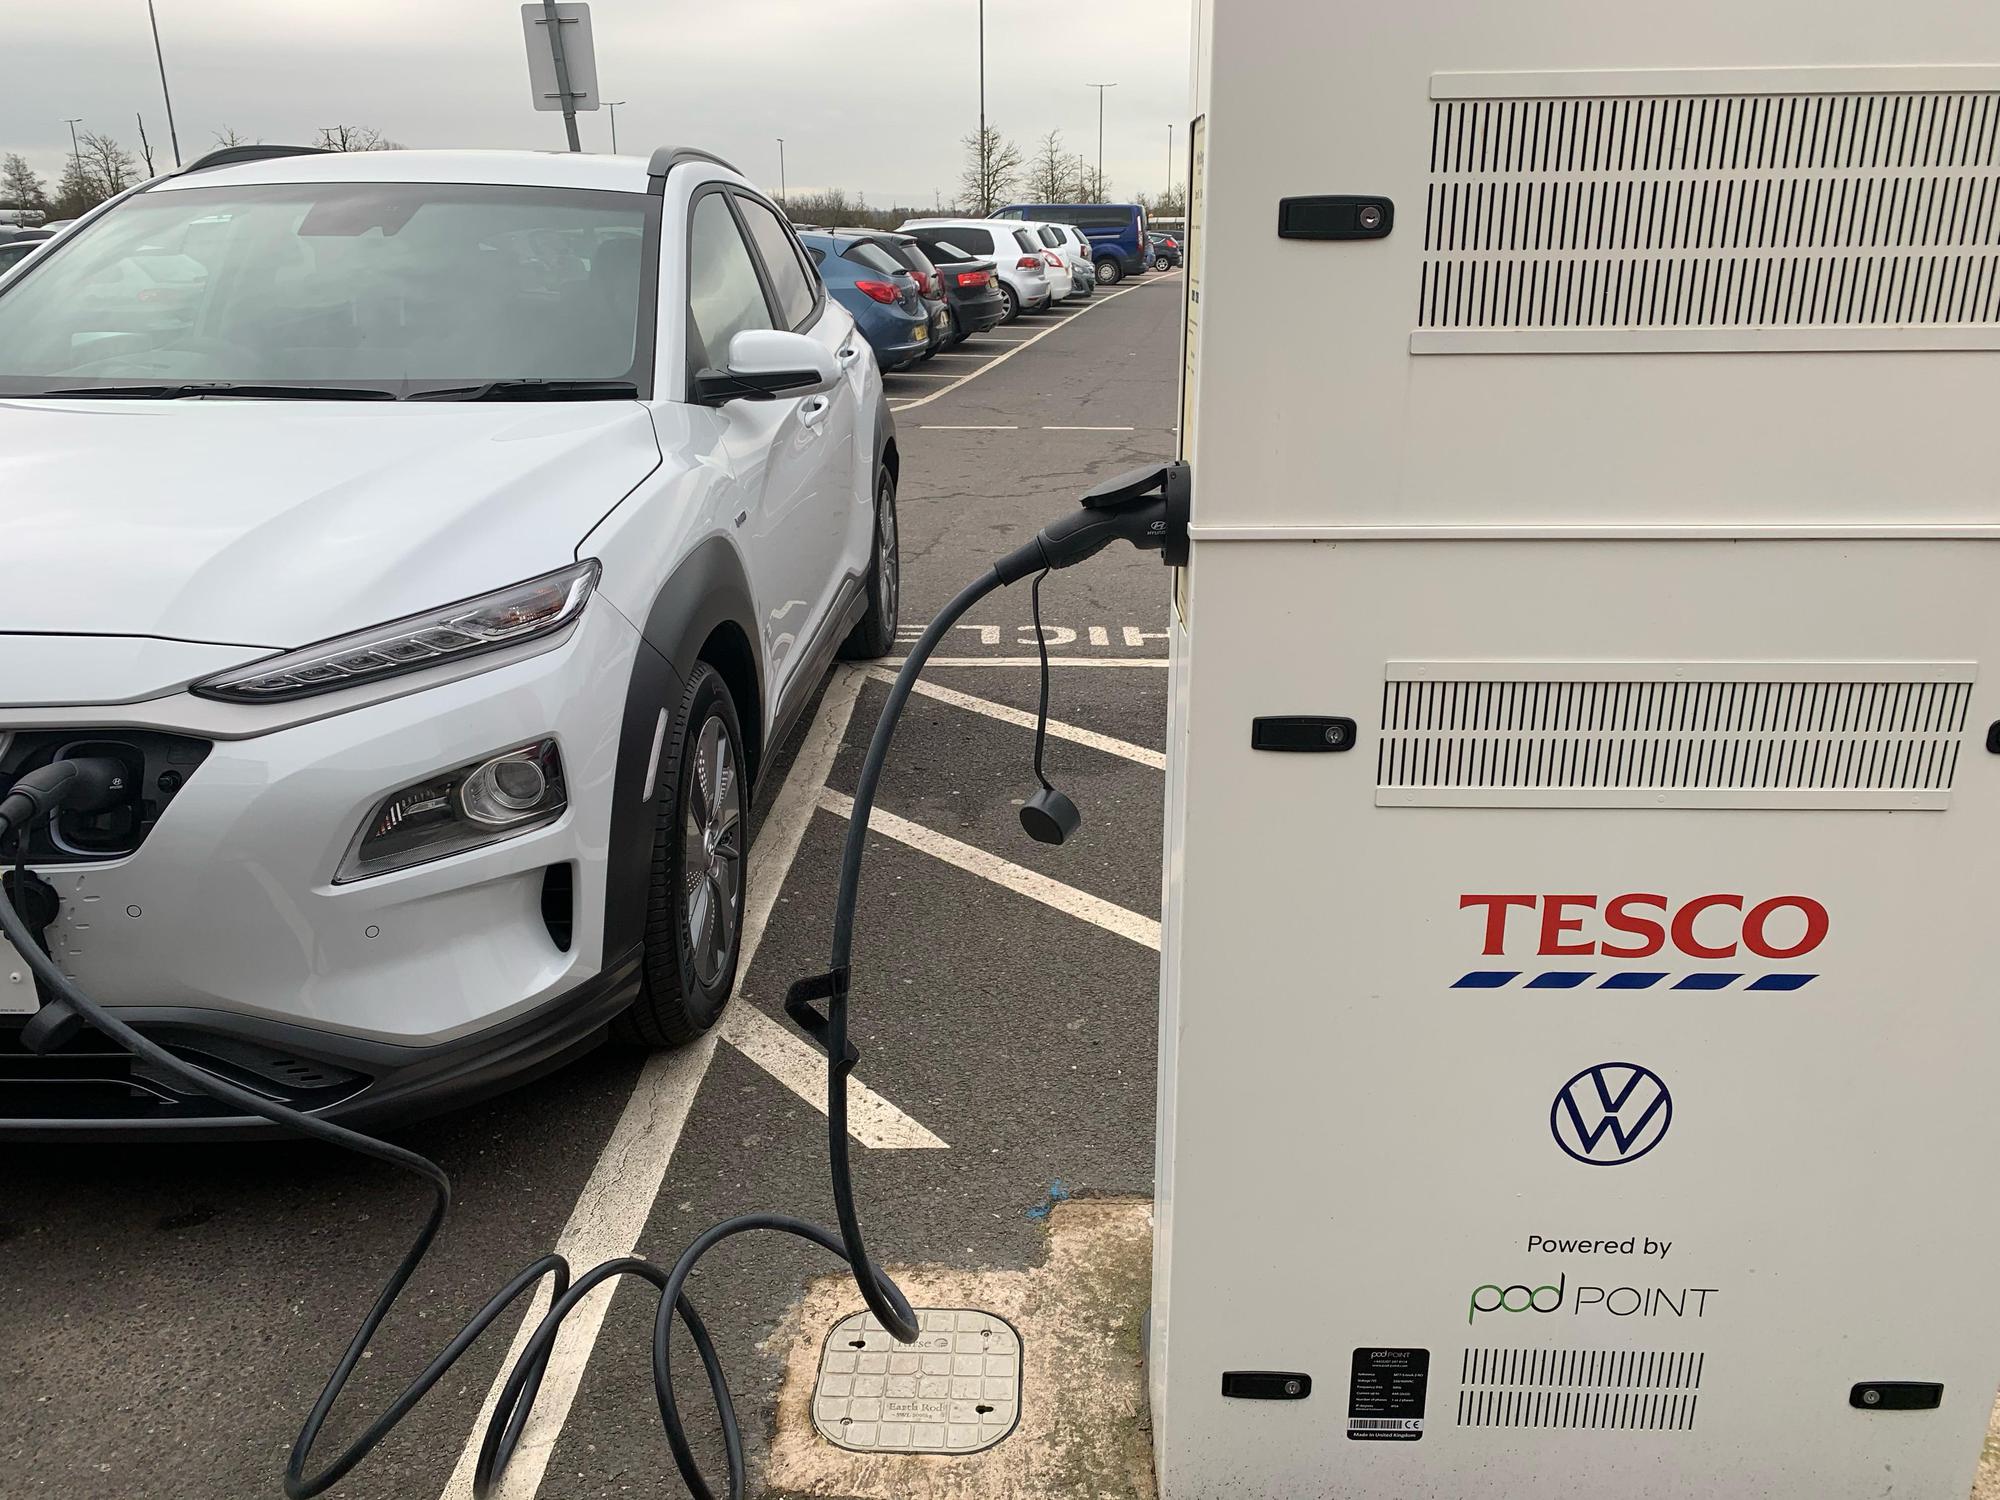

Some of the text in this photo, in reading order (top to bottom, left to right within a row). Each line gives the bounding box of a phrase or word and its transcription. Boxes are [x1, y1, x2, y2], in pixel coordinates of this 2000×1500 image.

[1459, 893, 1829, 959] TESCO
[1527, 1235, 1672, 1259] Powered by
[1468, 1272, 1719, 1325] pod POINT
